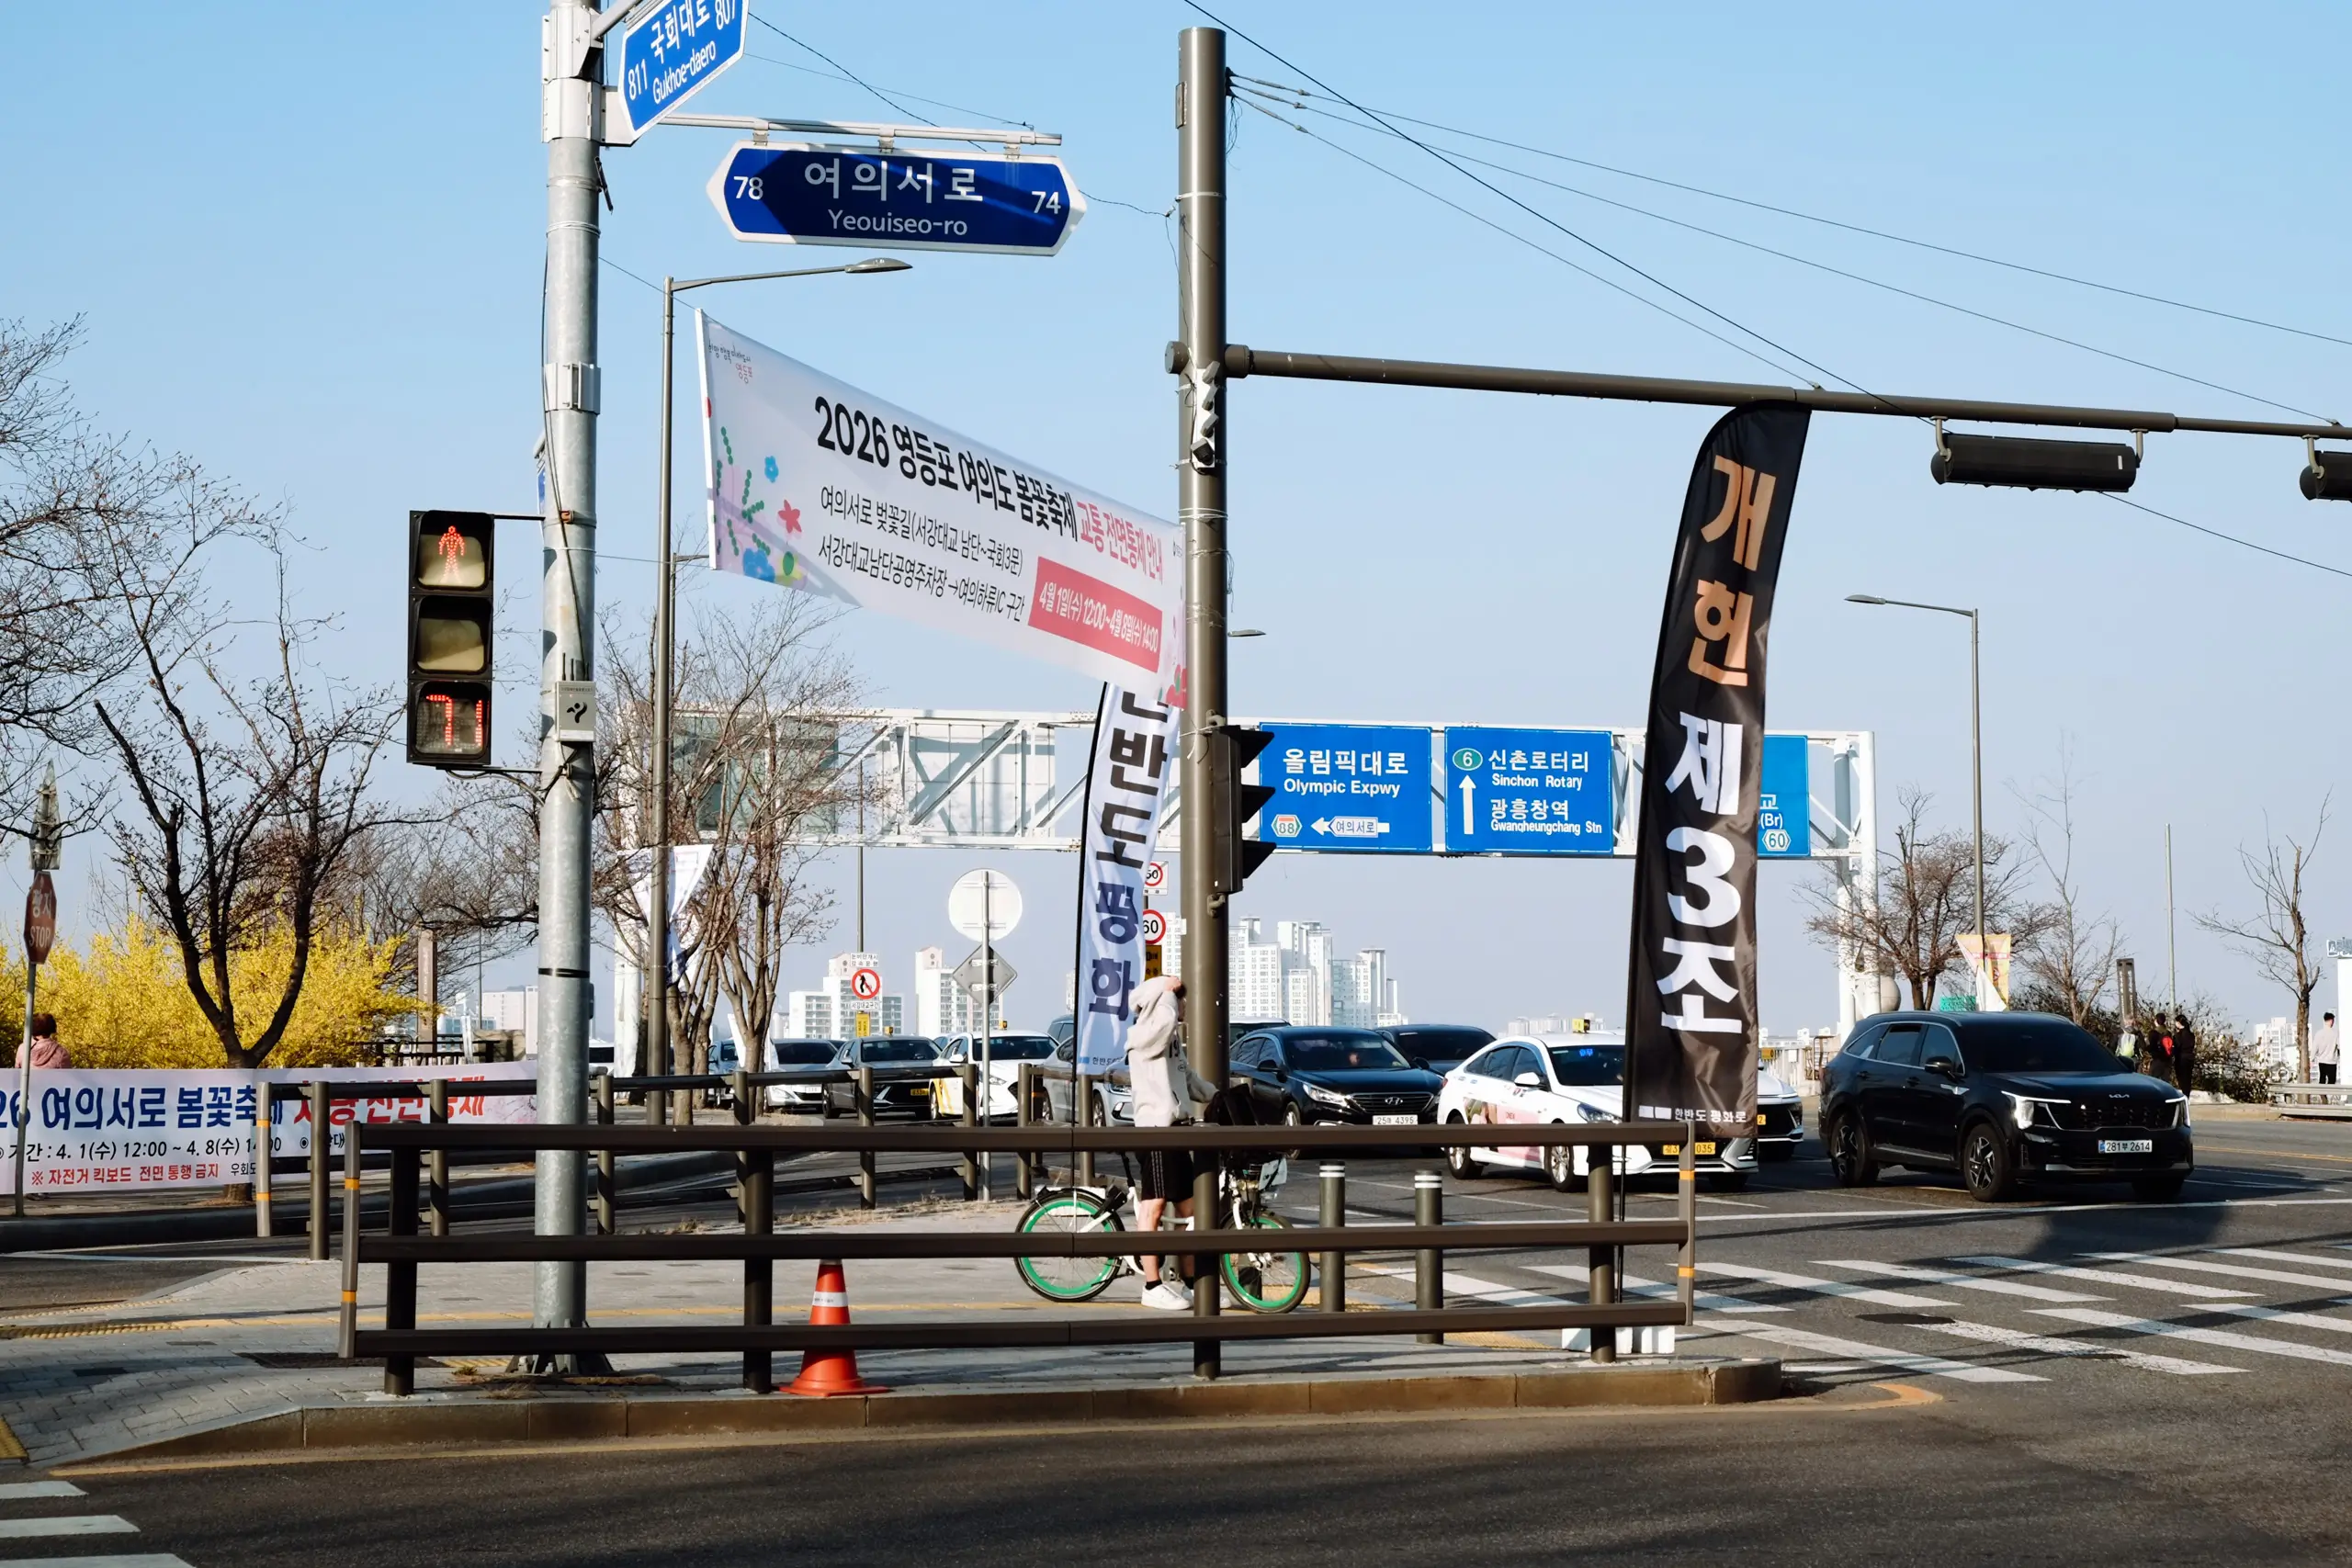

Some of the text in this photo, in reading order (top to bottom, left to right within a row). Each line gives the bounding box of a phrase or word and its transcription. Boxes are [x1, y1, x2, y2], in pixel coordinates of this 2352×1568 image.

[650, 0, 710, 64] 국회대로
[628, 59, 648, 101] 811
[652, 40, 716, 105] Gukhoe-daero
[733, 175, 763, 201] 78
[804, 157, 983, 204] 여의서로
[1031, 190, 1061, 214] 74
[827, 209, 967, 236] Yeouiseo-ro
[815, 396, 1163, 585] 2026 영등포 여의도 봄꽃축제 교통 전면통제 안내
[820, 485, 873, 525] 여의서로
[876, 501, 958, 553] 벚꽃길(서강대교
[819, 534, 947, 598] 서강대교남단공영주차장
[1006, 592, 1025, 623] 구간
[1039, 581, 1056, 613] 4월
[1057, 588, 1083, 622] 1일(수)
[1656, 455, 1776, 1034] 개헌 제3조
[1283, 748, 1408, 776] 올림픽대로
[1463, 751, 1473, 767] 6
[1488, 749, 1589, 773] 신촌로터리
[1283, 778, 1401, 797] Olympic Expwy
[1492, 773, 1582, 791] Sinchon Rotary
[1490, 798, 1569, 820] 광흥창역
[1335, 820, 1375, 834] 여의서로
[1585, 820, 1602, 834] Stn
[1769, 832, 1785, 848] 60
[29, 926, 51, 948] STOP
[1088, 881, 1139, 1021] 평화
[41, 1087, 166, 1131] 여의서로
[1674, 1108, 1706, 1122] 한반도
[1710, 1109, 1747, 1122] 평화로
[80, 1142, 116, 1161] 1(수)
[124, 1142, 166, 1157] 12:00
[205, 1138, 240, 1156] 8(수)
[2130, 1141, 2150, 1152] 2614
[49, 1168, 89, 1185] 자전거
[93, 1167, 131, 1183] 킥보드
[140, 1165, 164, 1182] 전면
[168, 1164, 192, 1181] 통행
[195, 1162, 219, 1179] 금지
